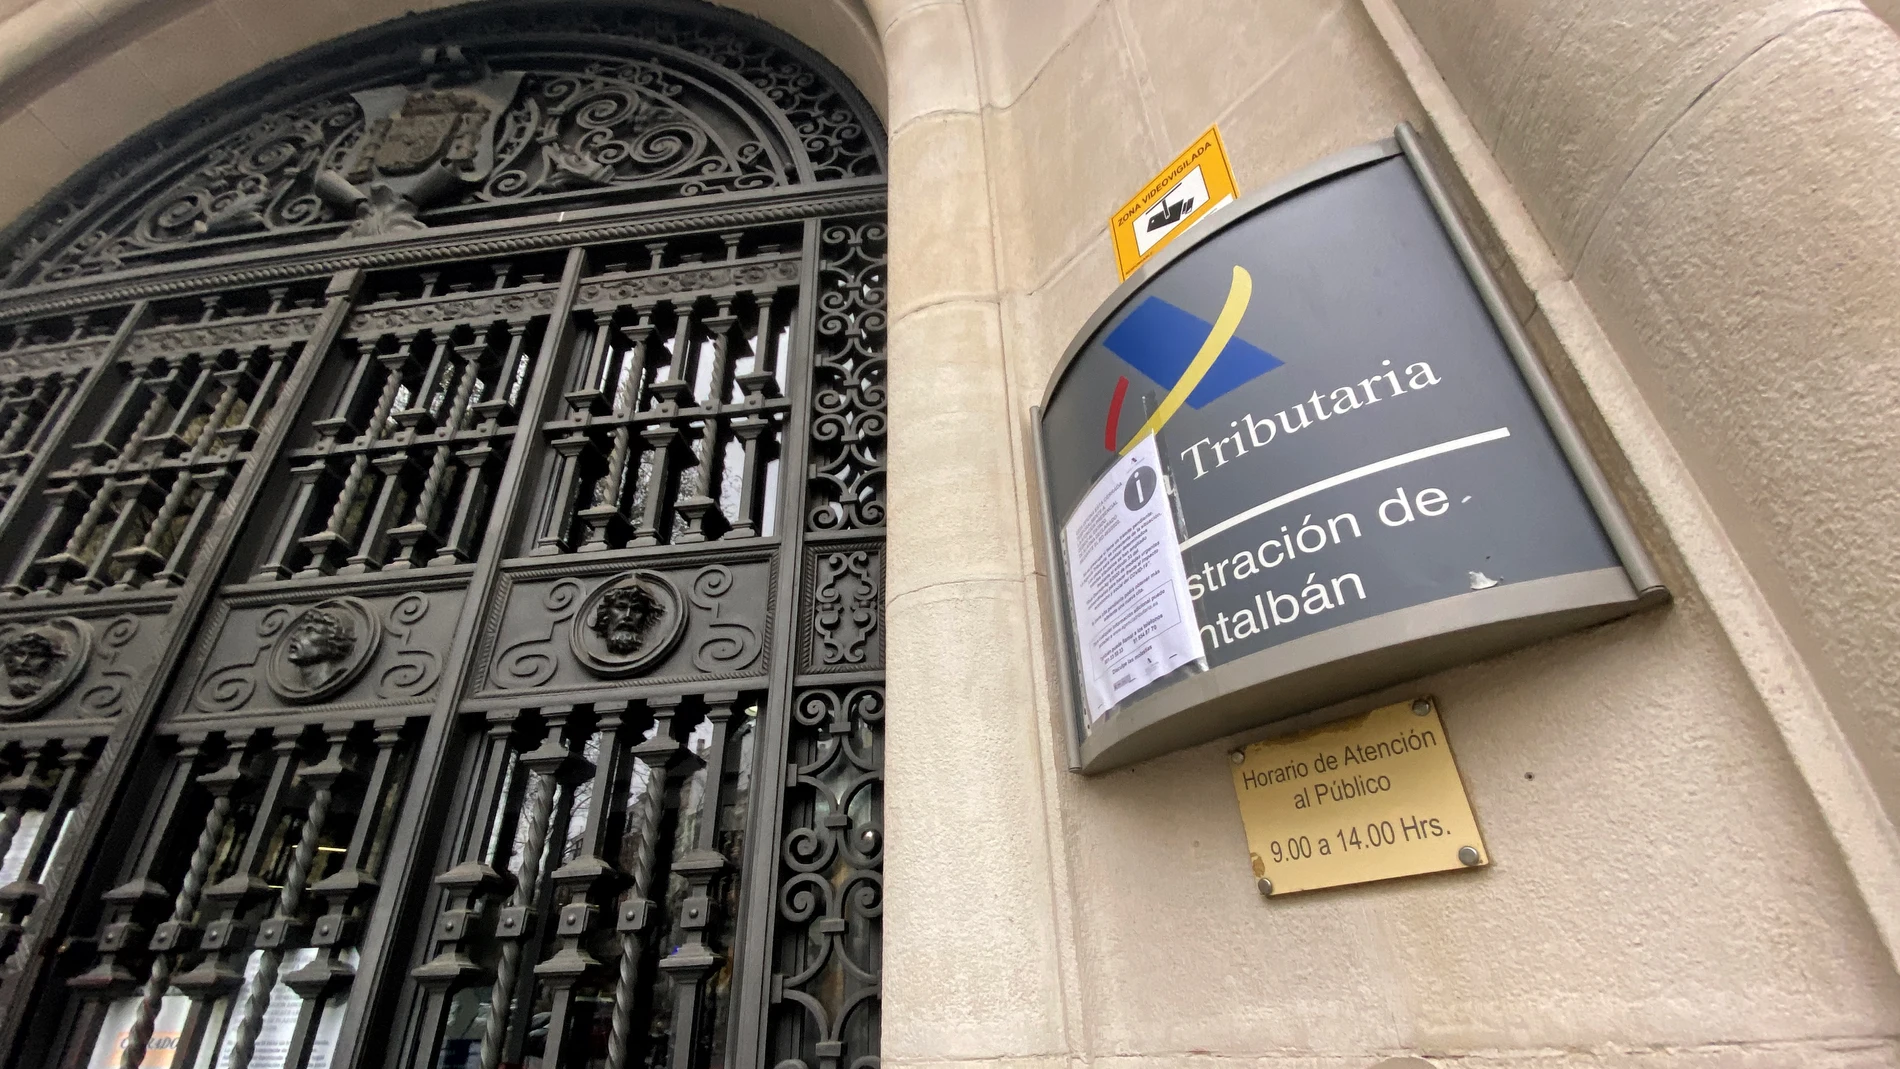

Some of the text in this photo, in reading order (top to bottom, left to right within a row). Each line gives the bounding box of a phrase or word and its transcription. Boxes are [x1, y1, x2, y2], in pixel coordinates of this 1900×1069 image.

[1117, 141, 1212, 228] ZONA VIDEOVIGILADA
[1180, 358, 1441, 480] Tributaria
[1378, 487, 1449, 527] de
[1243, 728, 1437, 791] Horario de Atención
[1294, 774, 1391, 810] al Público
[1270, 815, 1452, 864] 9.00 a 14.00 Hrs.
